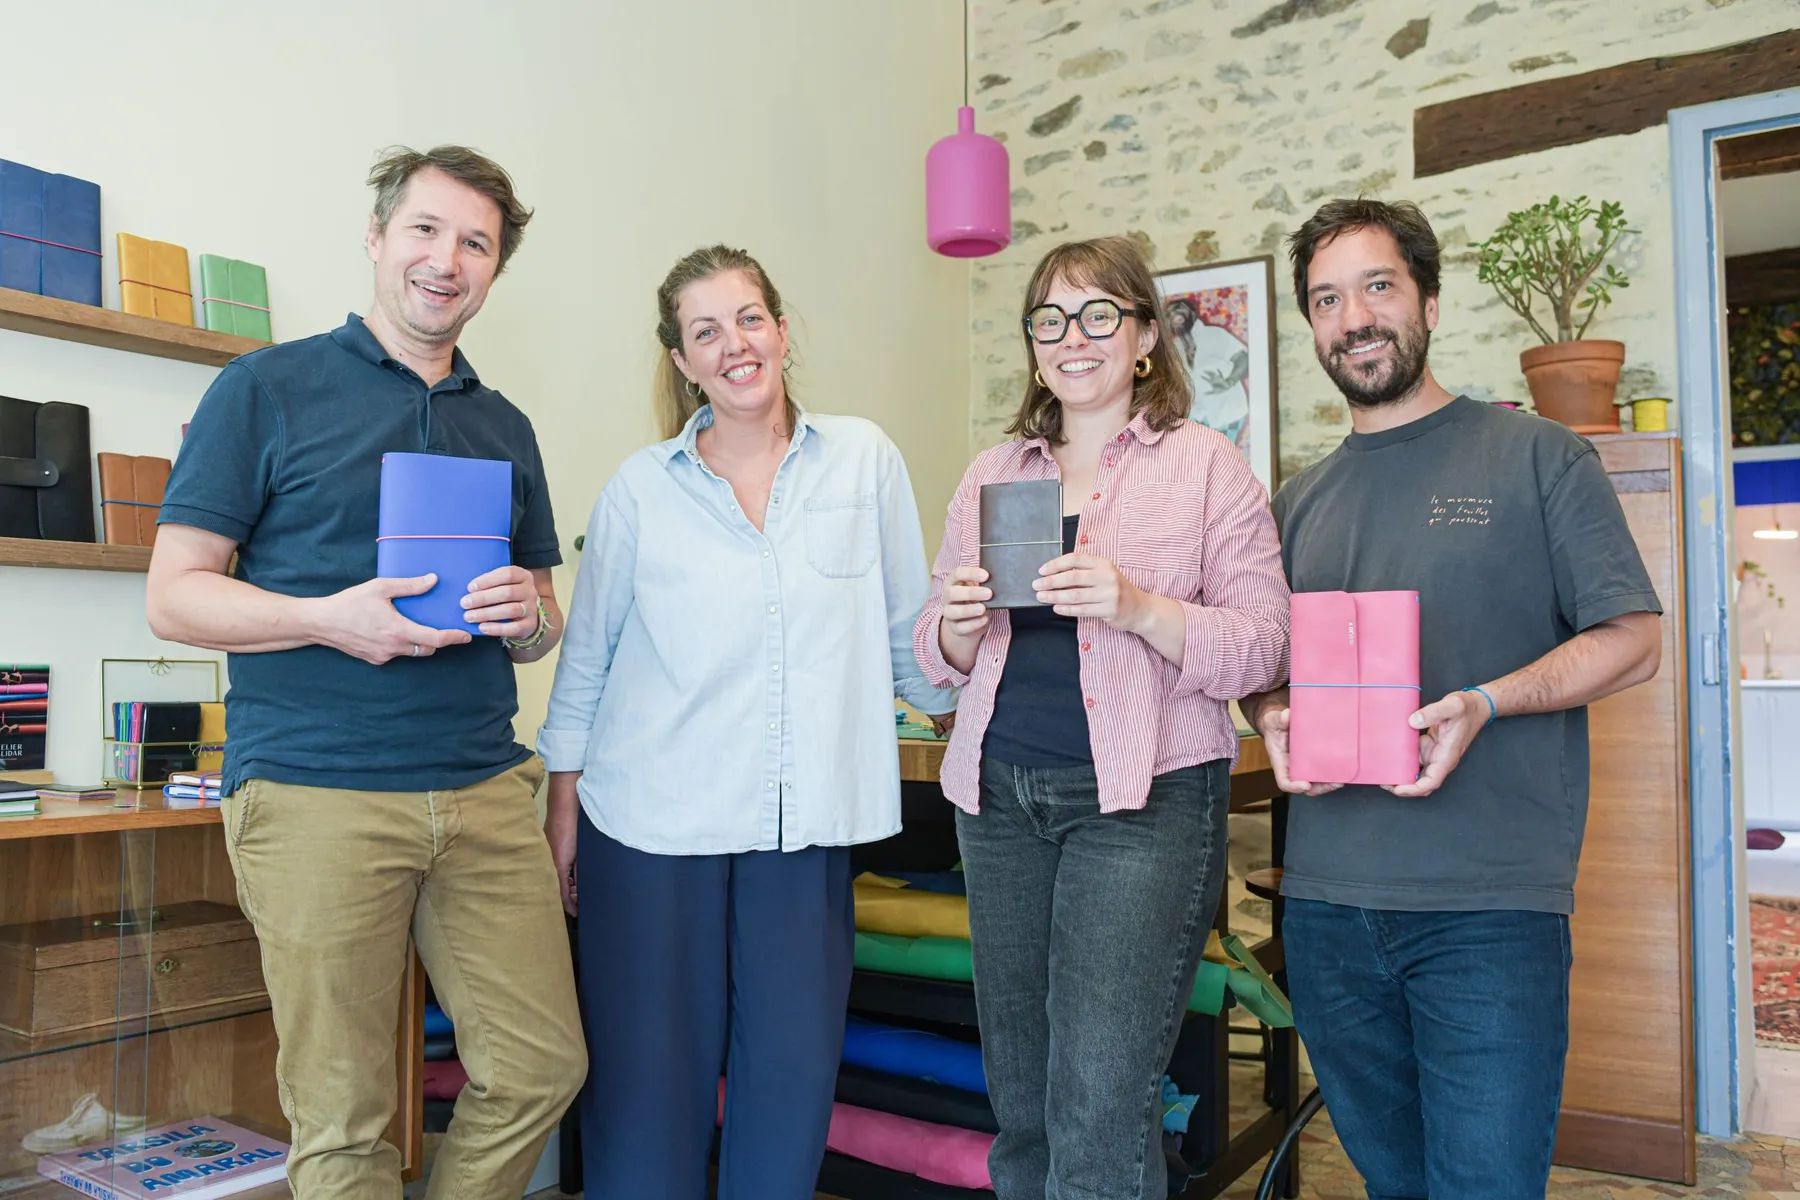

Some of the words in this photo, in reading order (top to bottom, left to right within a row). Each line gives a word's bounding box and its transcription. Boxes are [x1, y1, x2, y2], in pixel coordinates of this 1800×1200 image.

[1431, 495, 1439, 504] le
[1456, 505, 1488, 515] feuilles
[1448, 516, 1491, 525] poussent
[77, 1125, 218, 1161] TARSILA
[121, 1156, 174, 1174] DO
[140, 1148, 285, 1192] AMARAL
